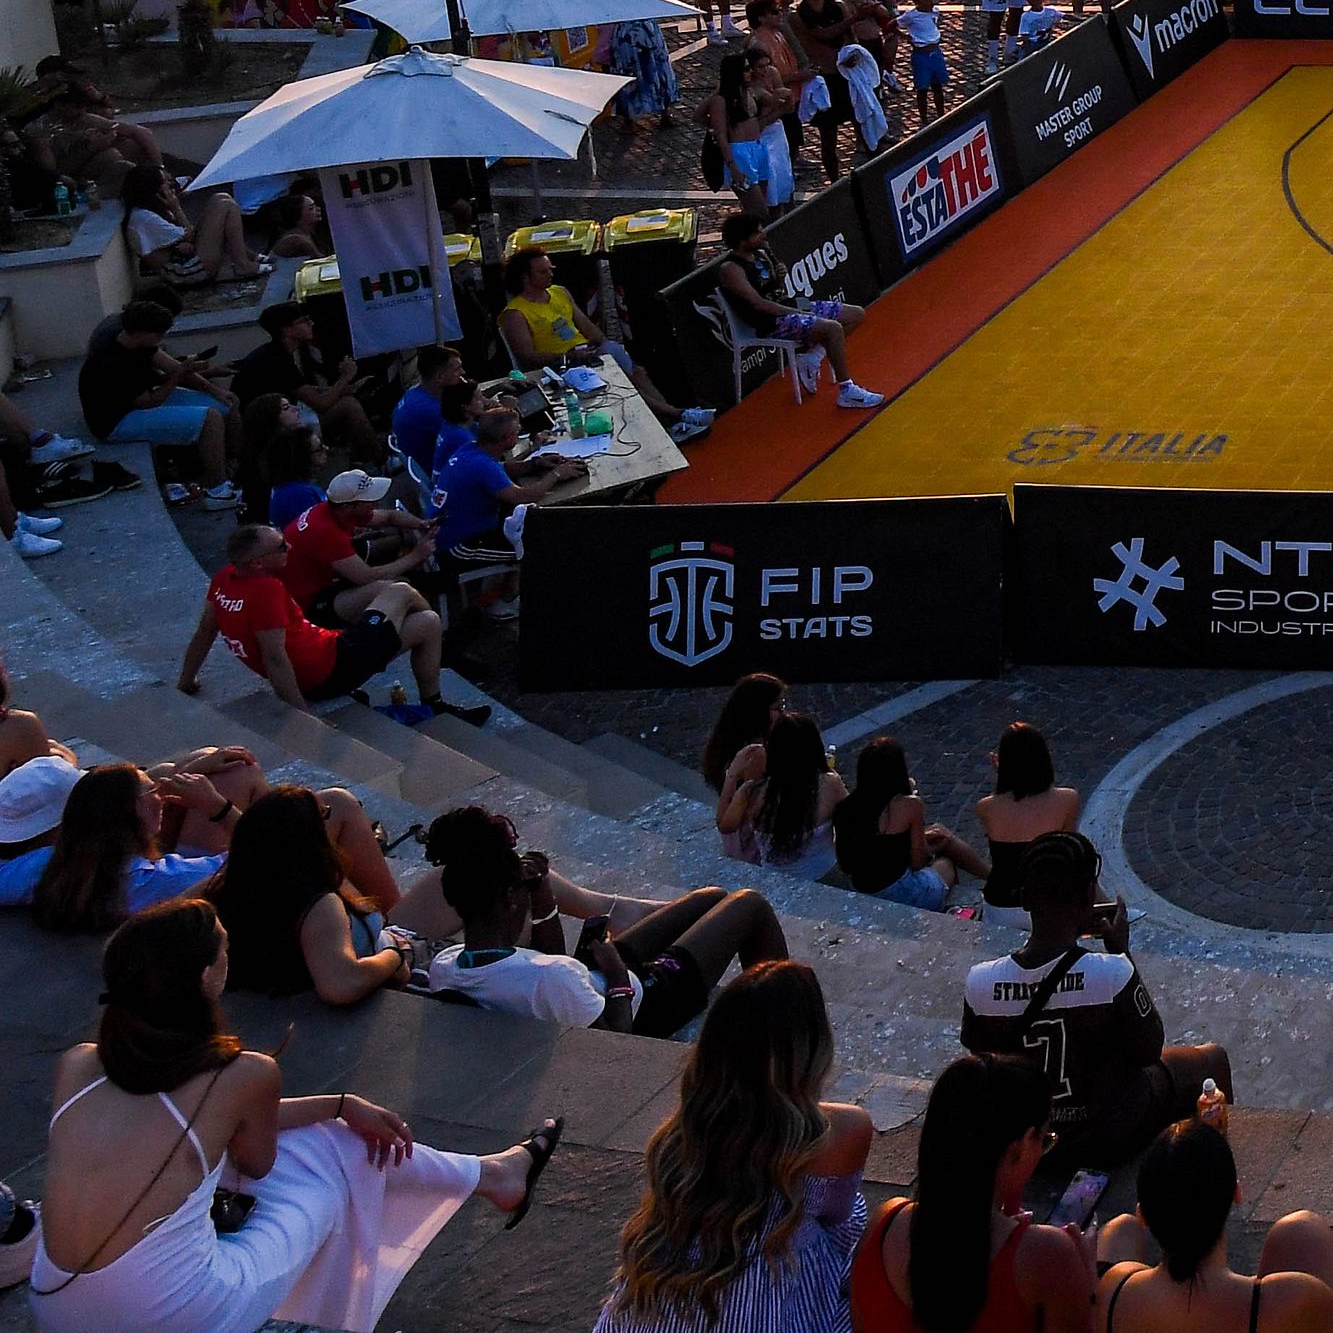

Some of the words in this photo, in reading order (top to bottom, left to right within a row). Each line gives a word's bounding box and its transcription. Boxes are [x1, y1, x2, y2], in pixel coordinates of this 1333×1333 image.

[1035, 106, 1074, 141] MASTER
[1072, 84, 1103, 116] GROUP
[1063, 117, 1095, 148] SPORT
[339, 161, 414, 199] HDI
[360, 265, 433, 302] HDI
[1100, 432, 1229, 456] ITALIA
[760, 565, 874, 606] FIP
[760, 615, 873, 640] STATS
